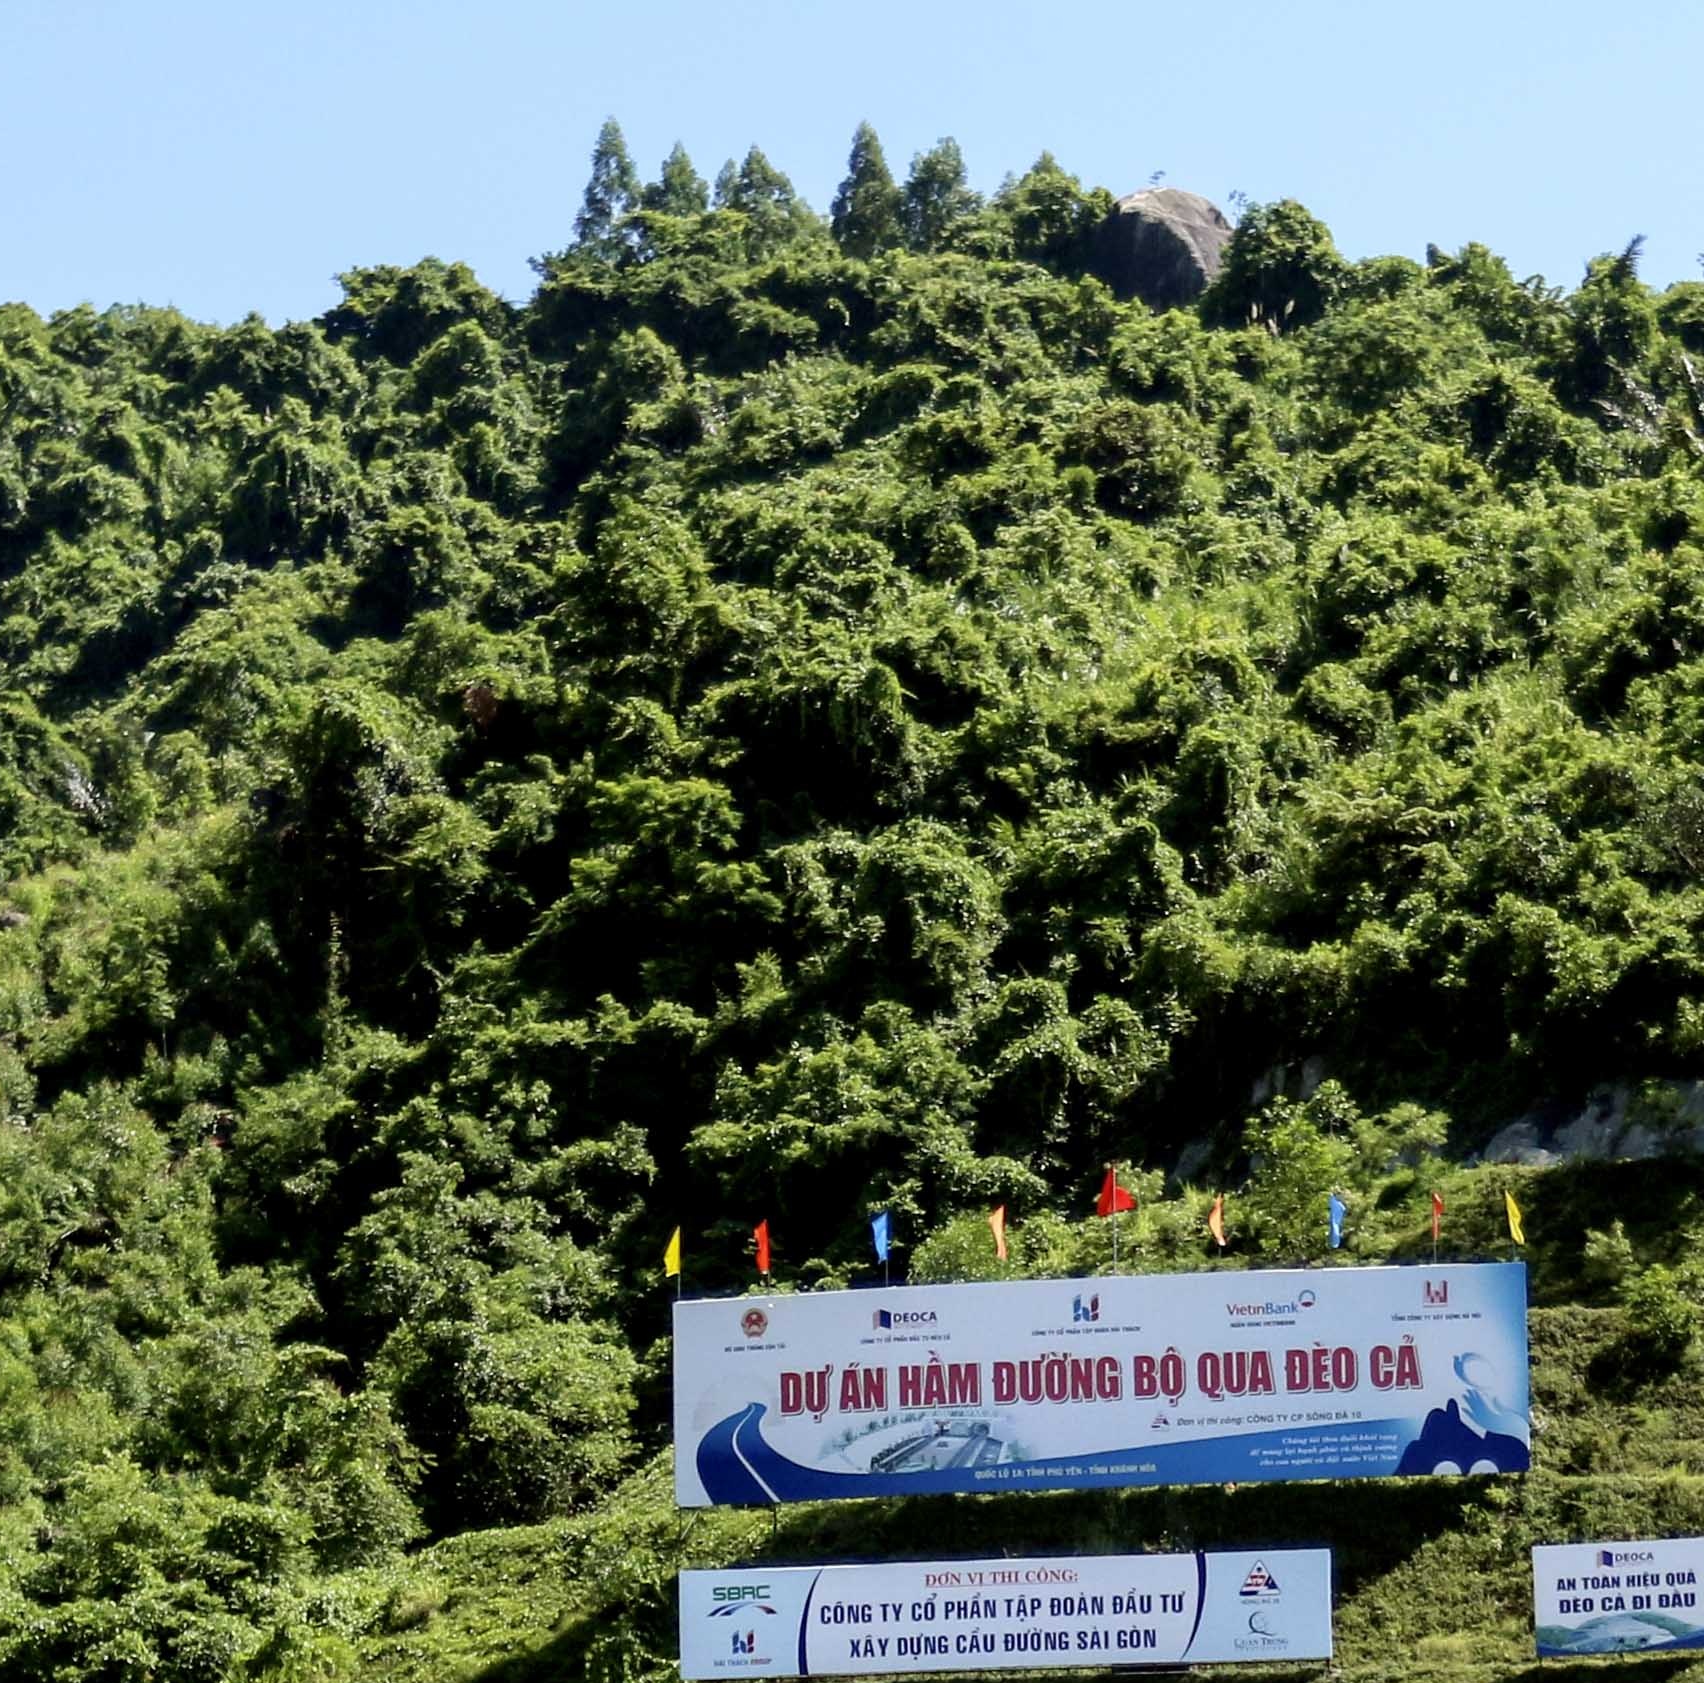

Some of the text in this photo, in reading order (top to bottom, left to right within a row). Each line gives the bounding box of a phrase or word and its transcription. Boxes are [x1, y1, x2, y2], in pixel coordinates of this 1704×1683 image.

[893, 1312, 938, 1323] DEOCA
[1226, 1302, 1298, 1316] VietinBank
[779, 1334, 1423, 1424] DỰ ÁN HẦM ĐƯỜNG BỘ QUA ĐÈO CẢ
[1247, 1411, 1274, 1423] CÔNG
[1277, 1414, 1288, 1422] TY
[1306, 1410, 1333, 1421] SÔNG
[1615, 1552, 1655, 1563] DEOCA
[925, 1566, 1078, 1587] ĐƠN VỊ THI CÔNG:
[1557, 1577, 1577, 1592] AN
[1581, 1573, 1621, 1590] TOÀN
[820, 1587, 1186, 1625] CÔNG TY CỔ PHẦN TẬP ĐOÀN ĐẦU TƯ
[1632, 1595, 1651, 1610] ĐI
[849, 1625, 1157, 1661] XÂY DỰNG CẦU ĐƯỜNG SÀI GÒN
